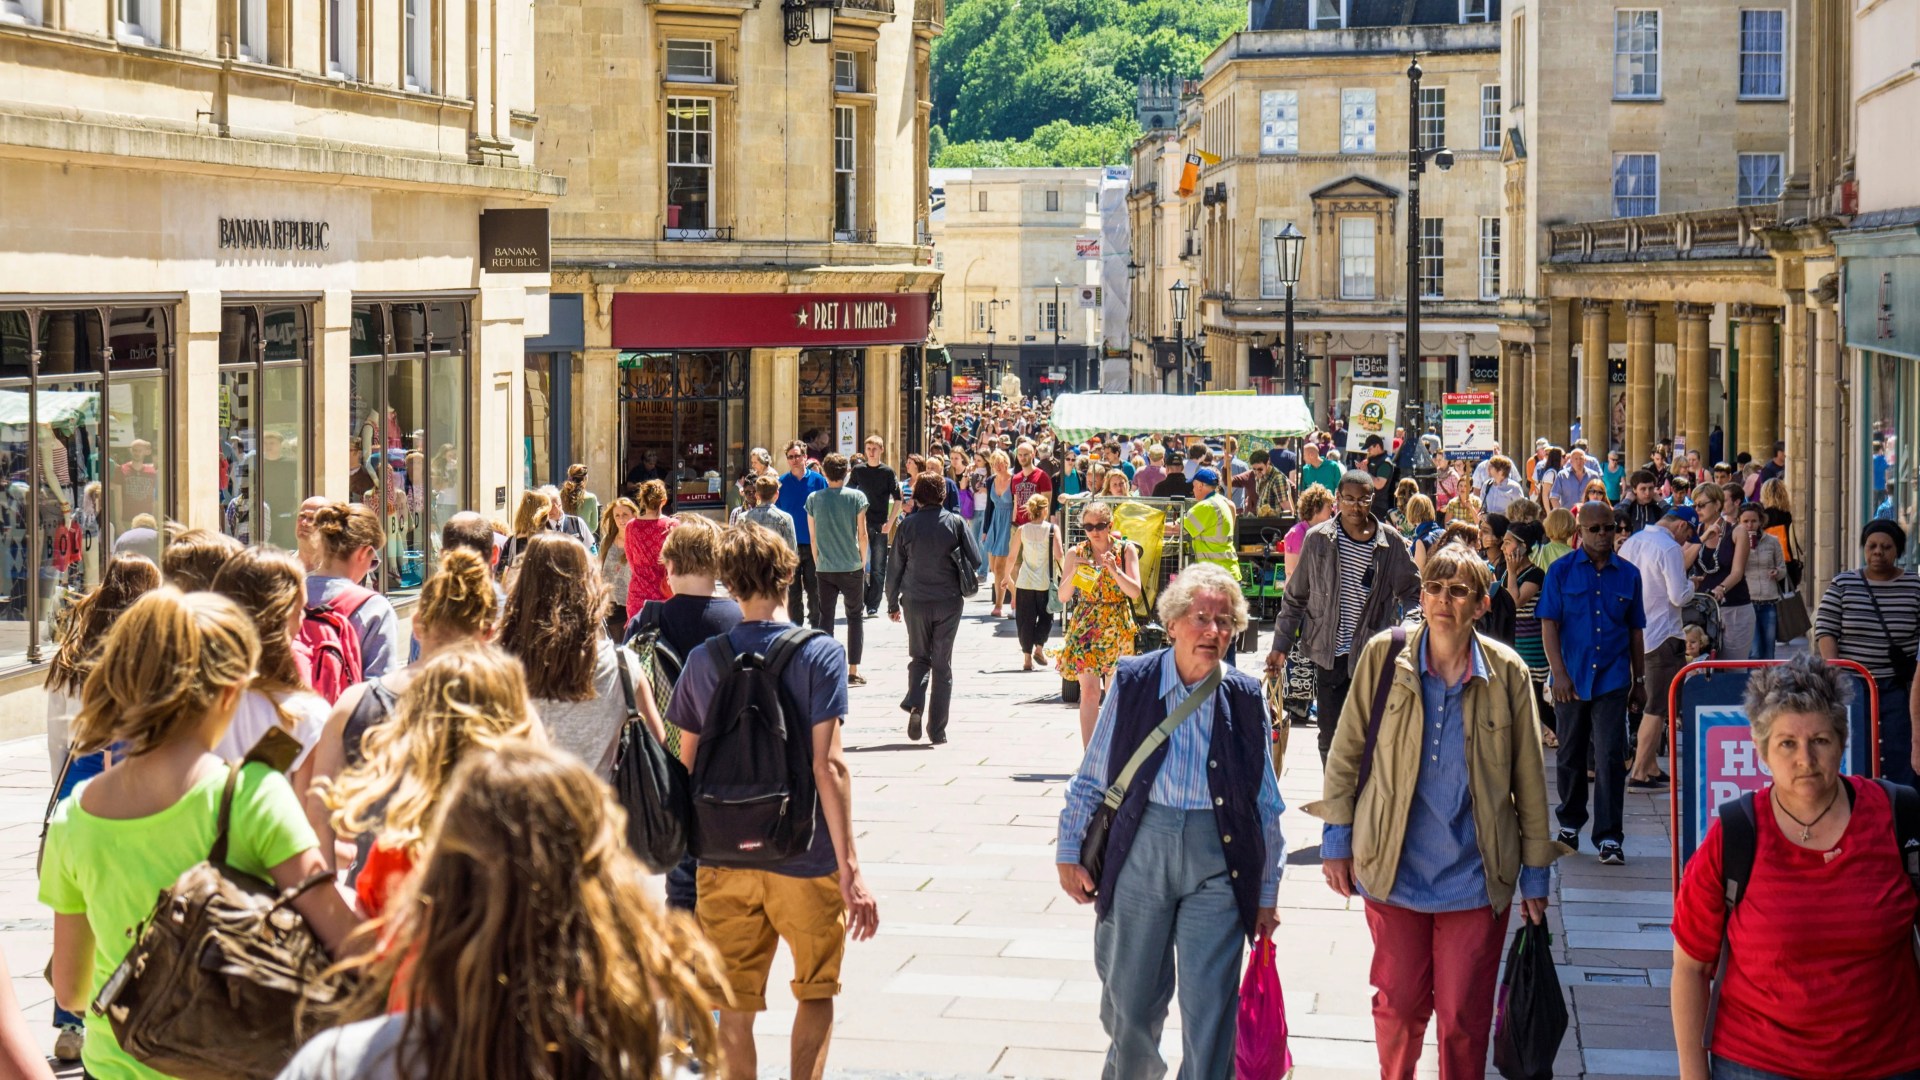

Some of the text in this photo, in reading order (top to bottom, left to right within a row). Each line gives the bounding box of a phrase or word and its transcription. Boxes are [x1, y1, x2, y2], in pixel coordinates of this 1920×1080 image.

[218, 217, 330, 251] BANANA REPUBLIC
[494, 247, 537, 256] BANANA
[492, 257, 541, 267] REPUBLIC
[814, 301, 888, 330] PRET A MANGER
[1371, 357, 1382, 365] Art
